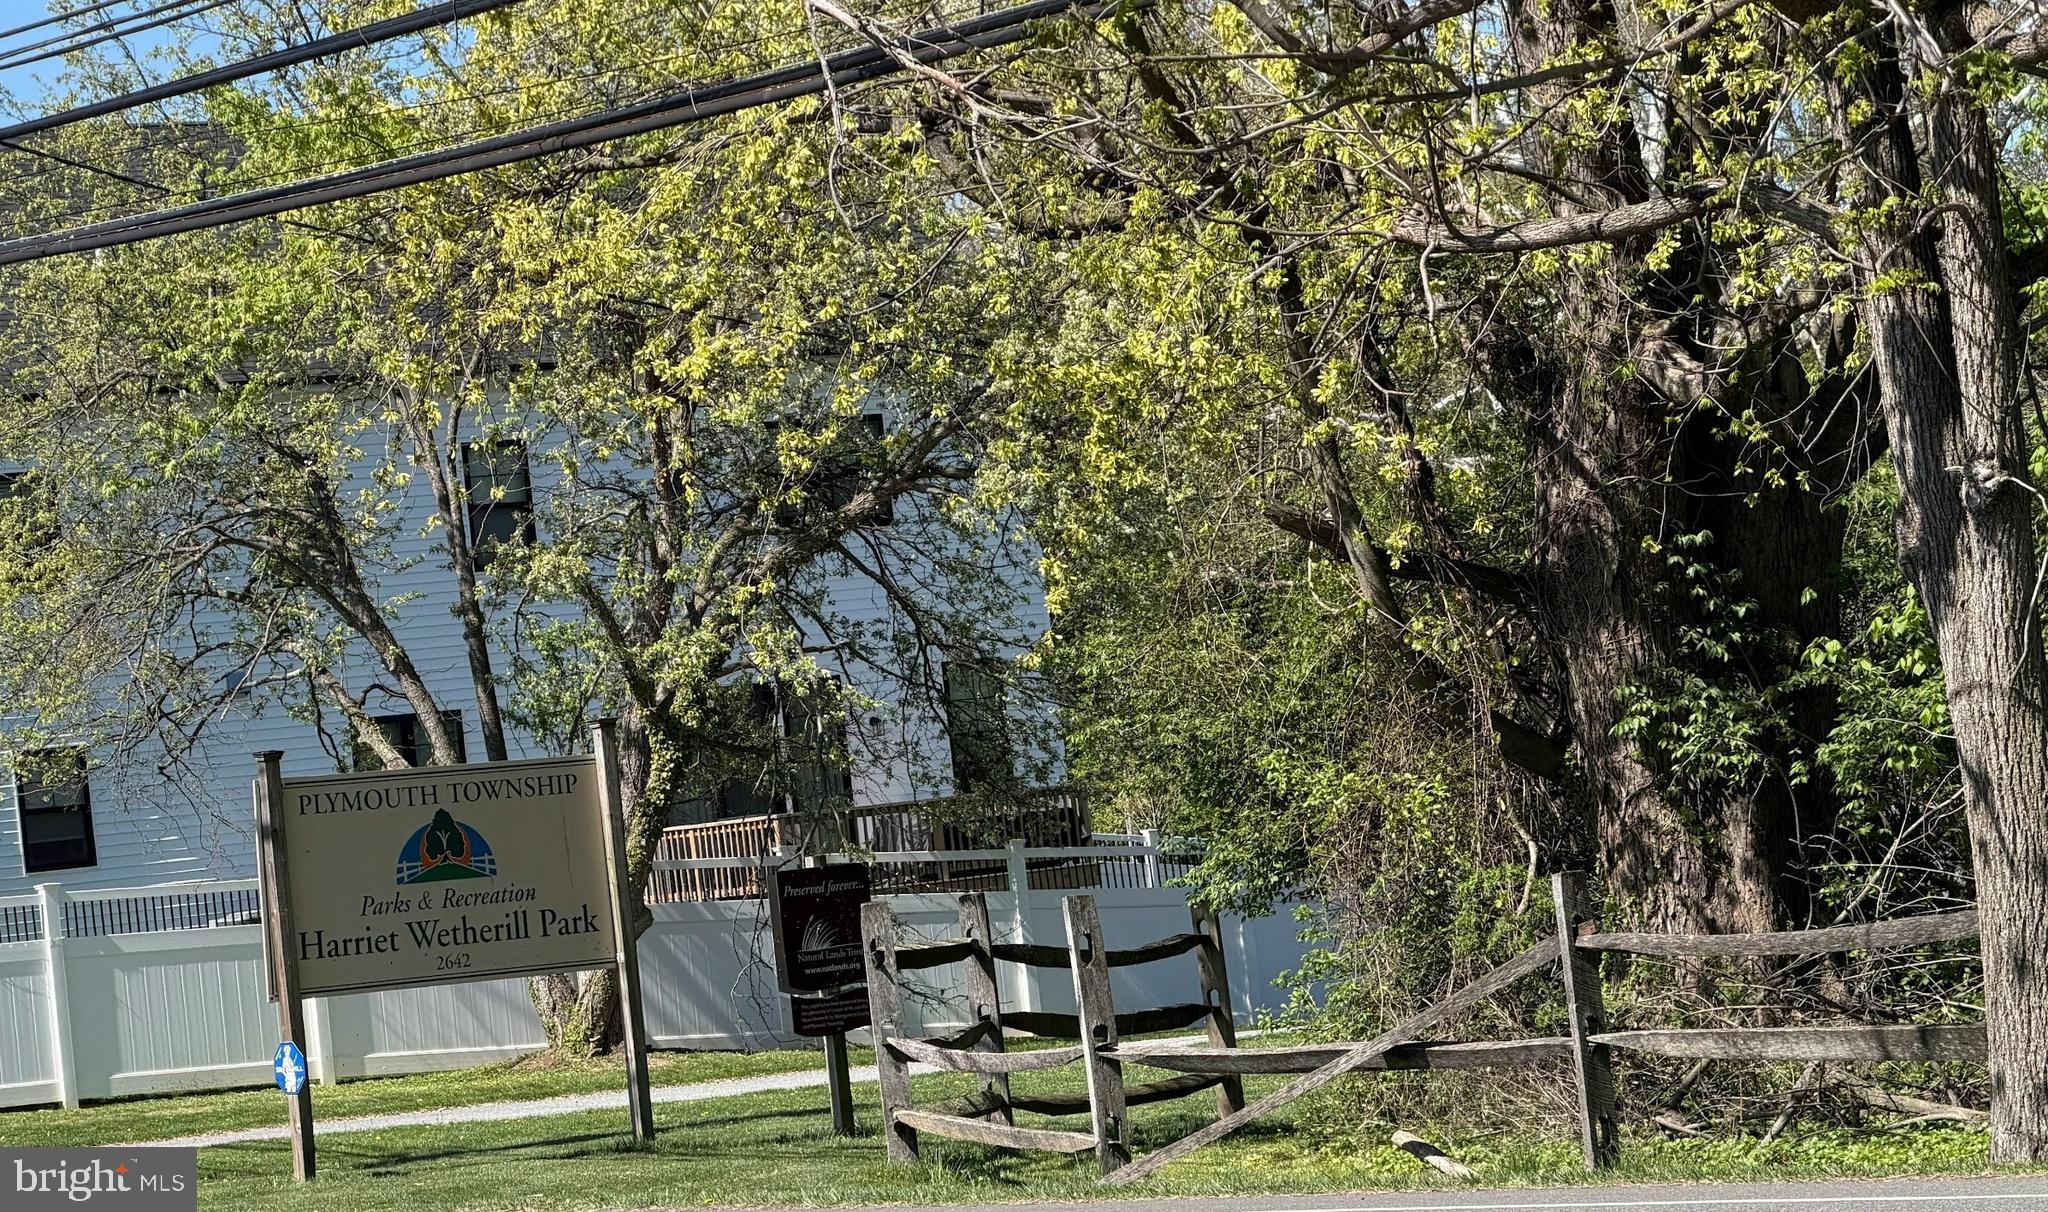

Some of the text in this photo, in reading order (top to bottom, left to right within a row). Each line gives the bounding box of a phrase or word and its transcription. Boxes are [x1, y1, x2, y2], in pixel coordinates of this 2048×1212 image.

[298, 773, 578, 816] PLYMOUTH TOWNSHIP
[784, 880, 864, 897] Preserved forever...
[360, 882, 537, 916] Parks & Recreation
[298, 904, 600, 961] Harriet Wetherill Park
[437, 952, 472, 971] 2642
[798, 951, 824, 963] Natural
[826, 949, 846, 959] Lands
[805, 962, 861, 975] www.natlands.org
